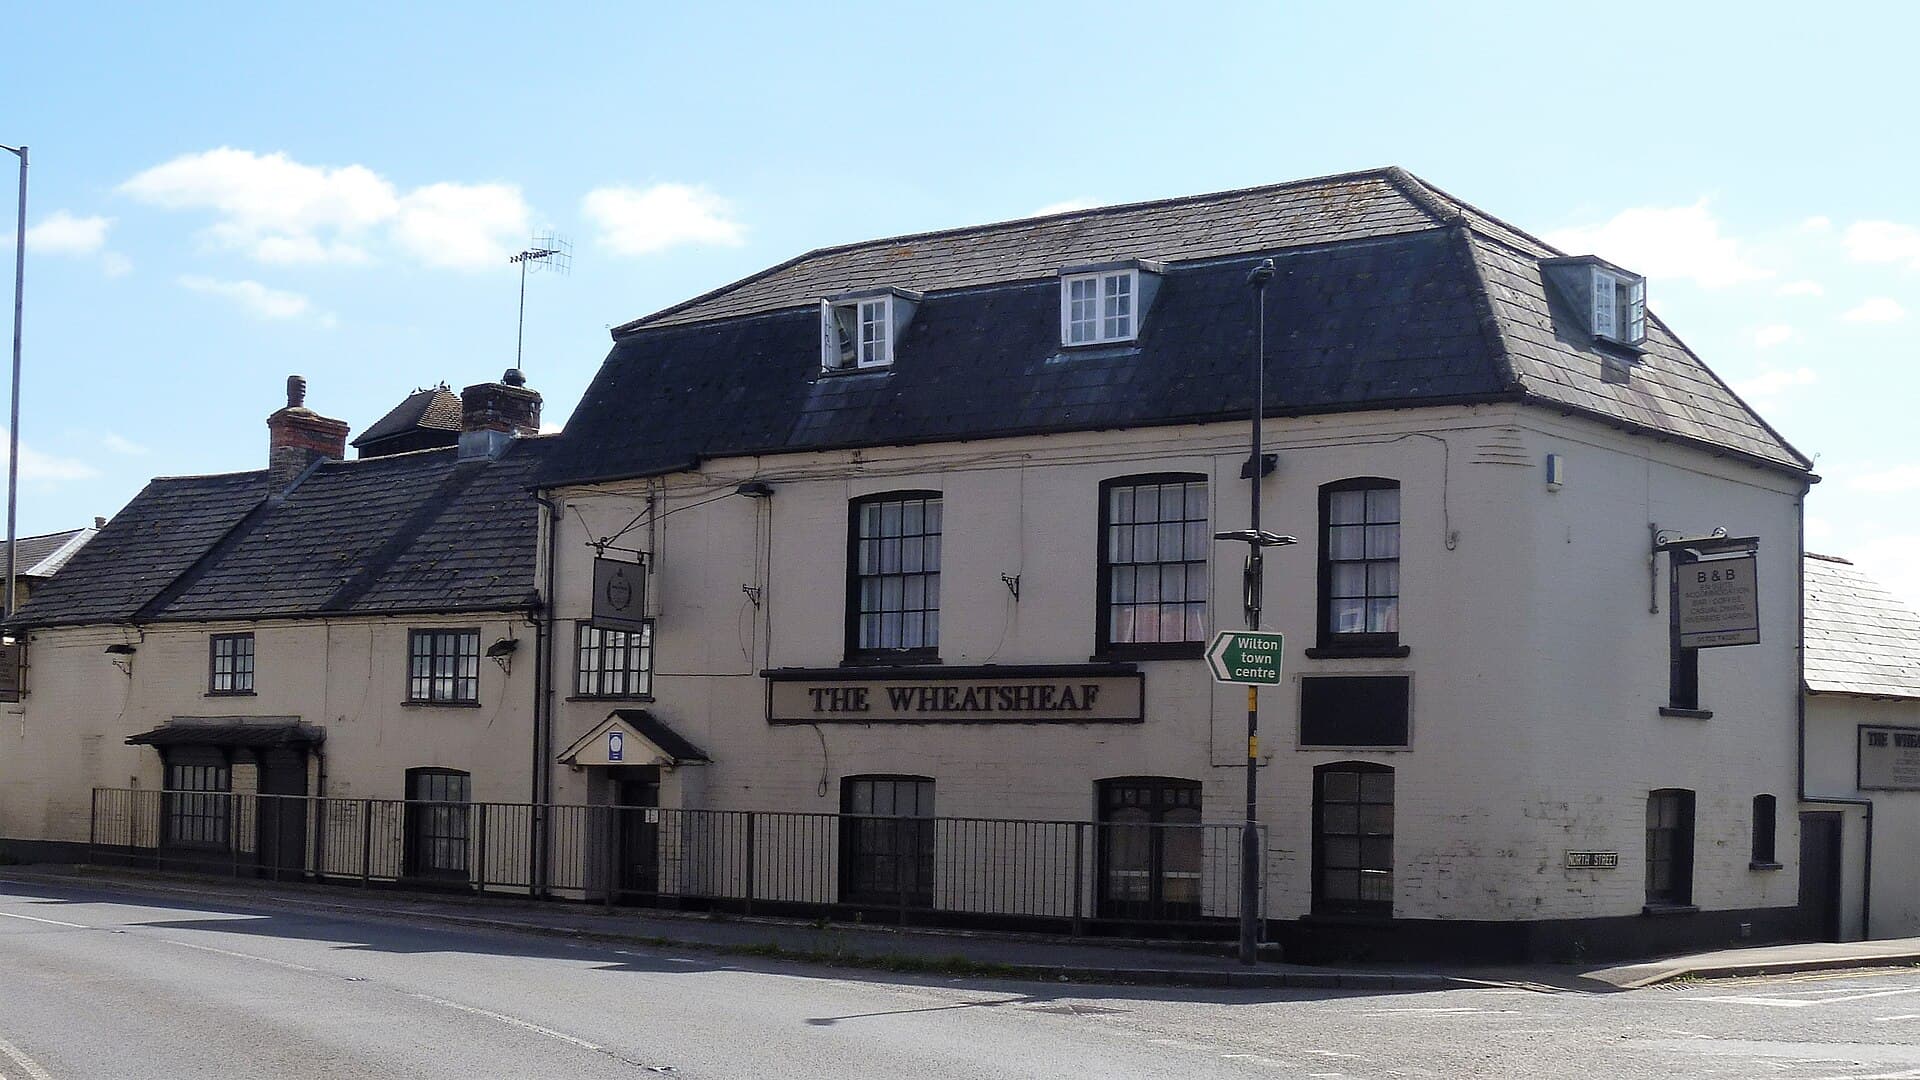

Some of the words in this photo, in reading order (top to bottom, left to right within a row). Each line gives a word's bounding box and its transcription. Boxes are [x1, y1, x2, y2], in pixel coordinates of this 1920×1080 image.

[1697, 571, 1706, 583] B
[1712, 570, 1721, 581] &
[1726, 569, 1736, 580] B
[1237, 637, 1278, 651] Wilton
[1241, 652, 1272, 664] town
[1235, 667, 1276, 679] centre
[808, 686, 869, 712] THE
[886, 684, 1100, 712] WHEATSHEAF
[1867, 731, 1889, 747] THE
[1568, 854, 1590, 865] NORTH
[1593, 854, 1617, 866] STREET
